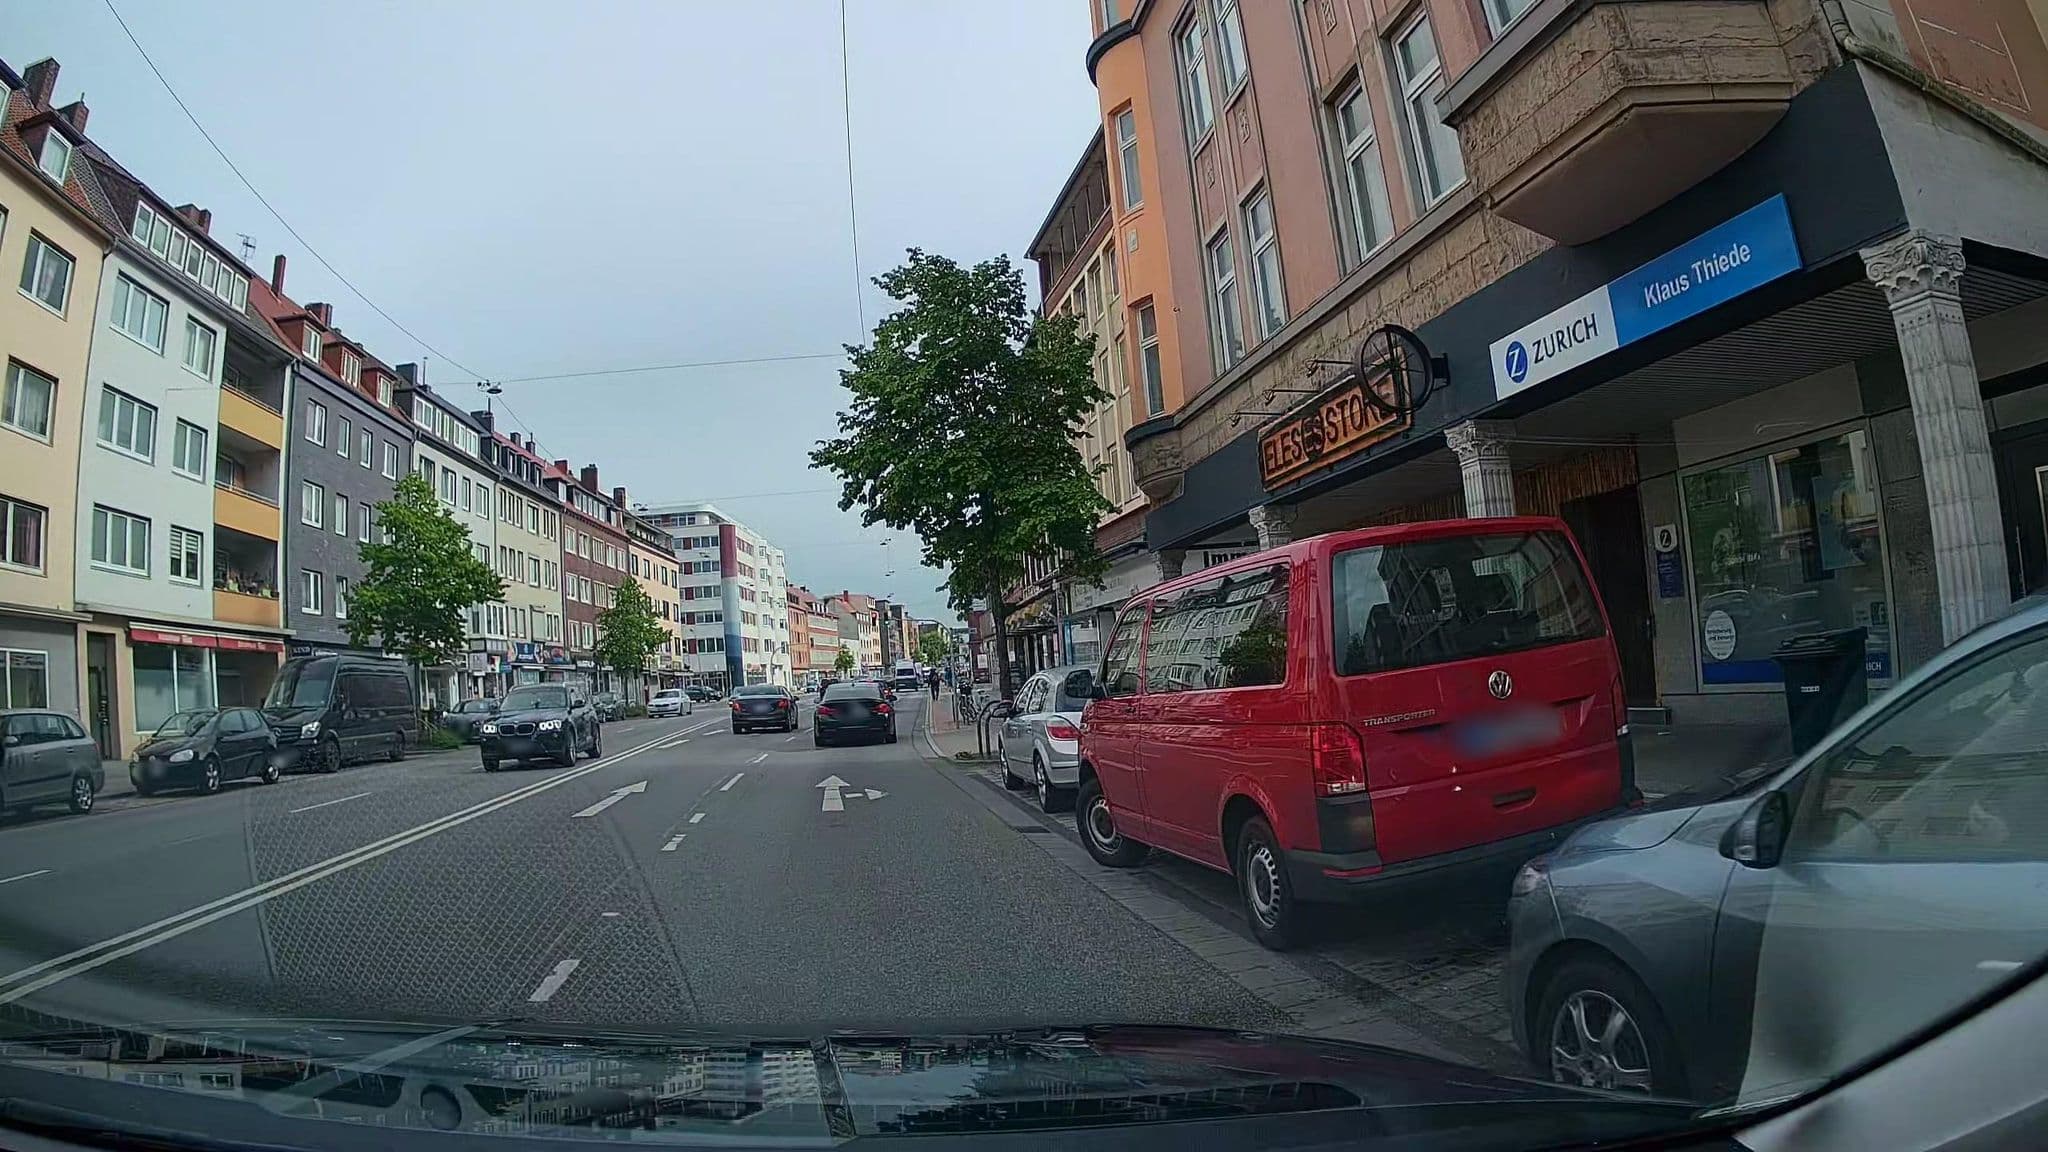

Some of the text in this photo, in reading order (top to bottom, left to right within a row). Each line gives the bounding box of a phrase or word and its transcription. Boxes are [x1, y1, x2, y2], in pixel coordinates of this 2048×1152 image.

[1644, 243, 1751, 308] Klaus Thiede
[1532, 312, 1599, 364] ZURICH
[1363, 708, 1436, 727] TRANSPORTER
